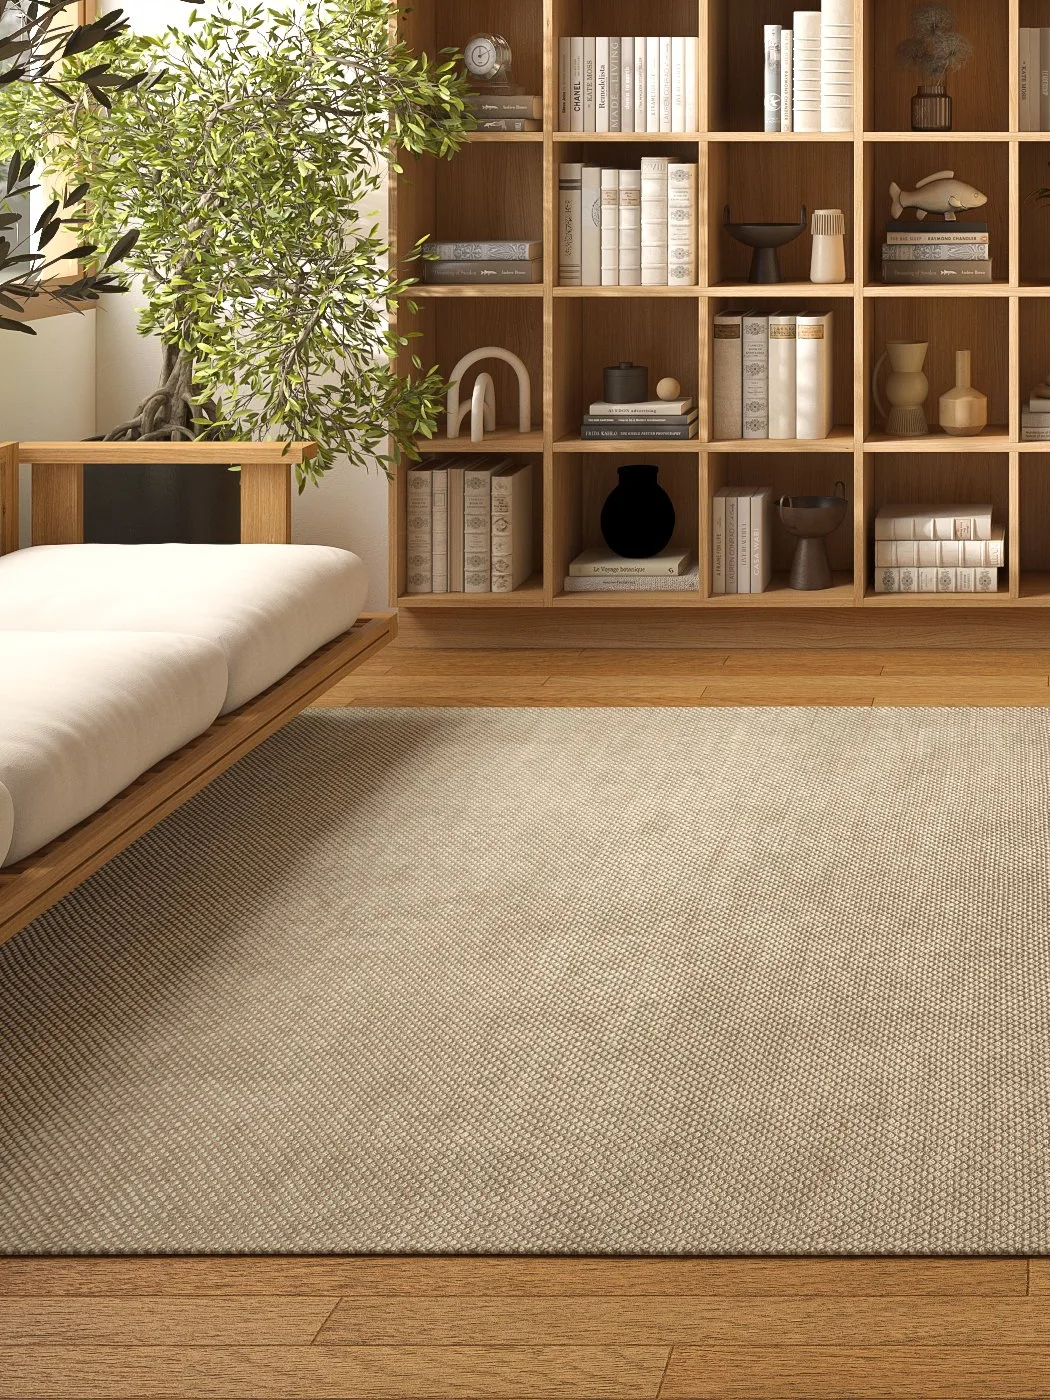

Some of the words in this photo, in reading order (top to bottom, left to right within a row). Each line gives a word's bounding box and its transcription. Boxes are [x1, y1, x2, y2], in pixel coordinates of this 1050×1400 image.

[610, 41, 619, 83] LIVING
[573, 81, 581, 112] CHANEL
[598, 64, 606, 109] Remodelista
[728, 528, 736, 556] CONRAD
[753, 528, 761, 551] WABI
[728, 557, 736, 584] LAUREN
[753, 553, 761, 576] CASA
